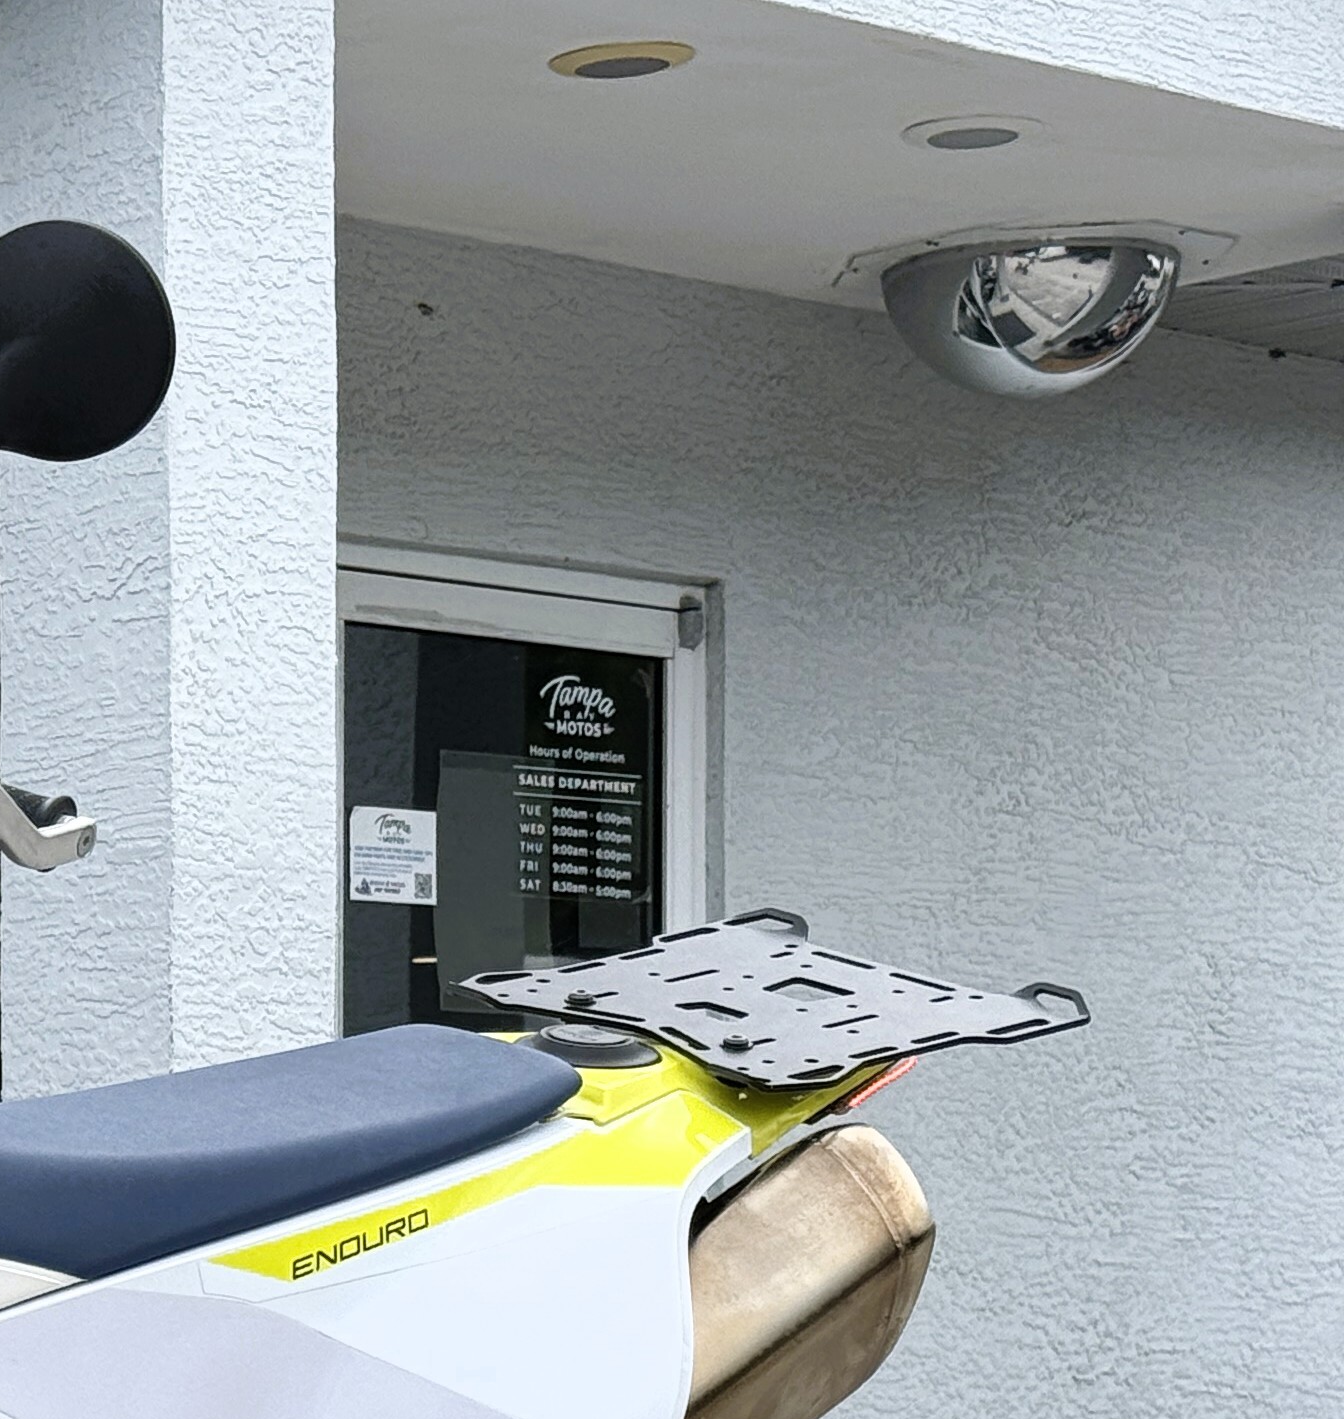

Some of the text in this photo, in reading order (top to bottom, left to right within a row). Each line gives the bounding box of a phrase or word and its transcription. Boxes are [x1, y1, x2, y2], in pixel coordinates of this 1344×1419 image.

[539, 675, 616, 719] Tampa
[557, 720, 602, 738] MOTOS
[529, 744, 626, 764] Hours of Operation
[518, 773, 636, 795] SALES DEPARTMENT
[519, 803, 541, 817] TUE
[552, 806, 588, 820] 9:00am
[596, 811, 632, 827] 6:00pm
[519, 823, 546, 835] WED
[552, 825, 588, 838] 9:00am
[596, 830, 632, 844] 6:00pm
[519, 841, 543, 855] THU
[552, 843, 588, 857] 9:00am
[596, 848, 632, 863] 6:00pm
[519, 859, 539, 872] FRI
[552, 862, 588, 875] 9:00am
[596, 866, 632, 882] 6:00pm
[519, 878, 541, 891] SAT
[292, 1208, 429, 1281] ENDURO
